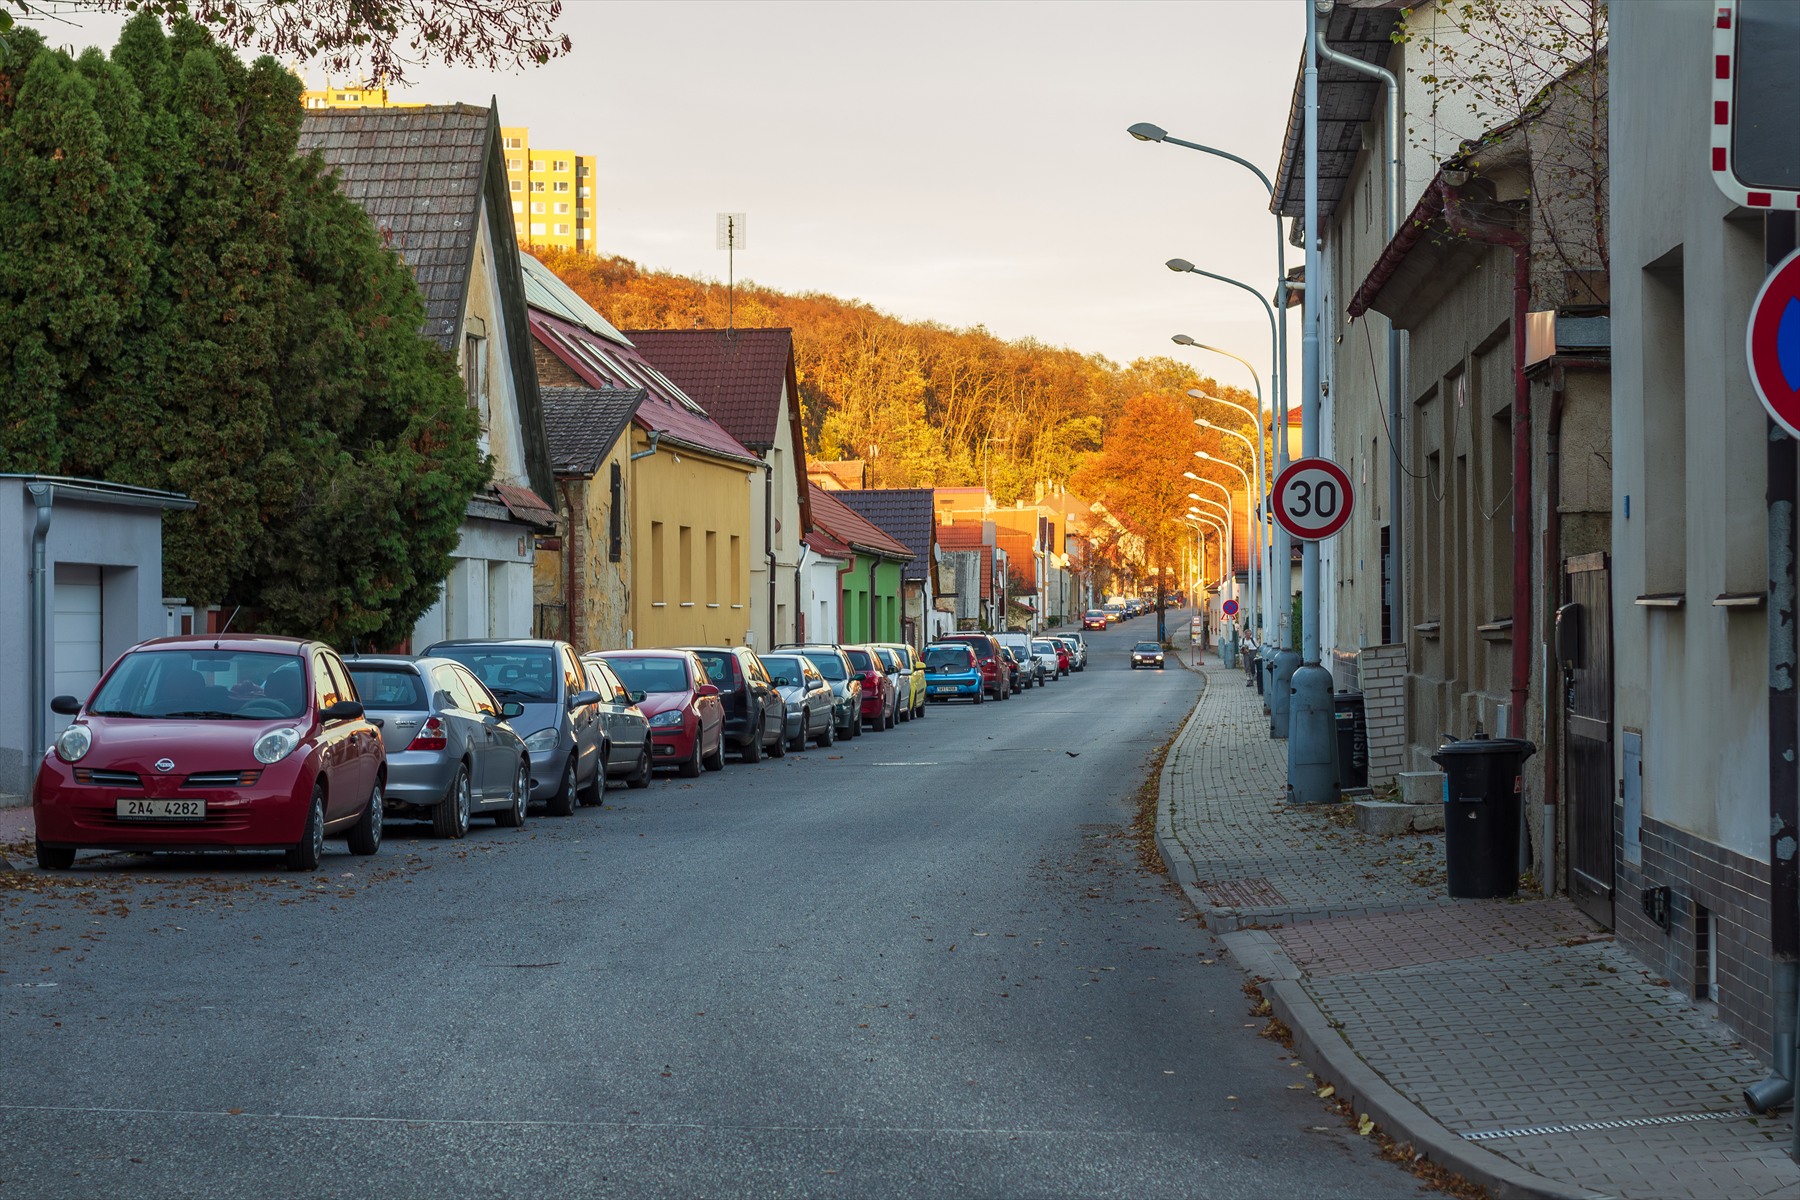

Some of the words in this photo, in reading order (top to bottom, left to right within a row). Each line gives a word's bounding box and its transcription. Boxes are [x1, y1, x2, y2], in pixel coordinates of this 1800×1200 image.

[1289, 480, 1336, 518] 30
[128, 802, 154, 815] 2A4
[164, 802, 199, 815] 4282
